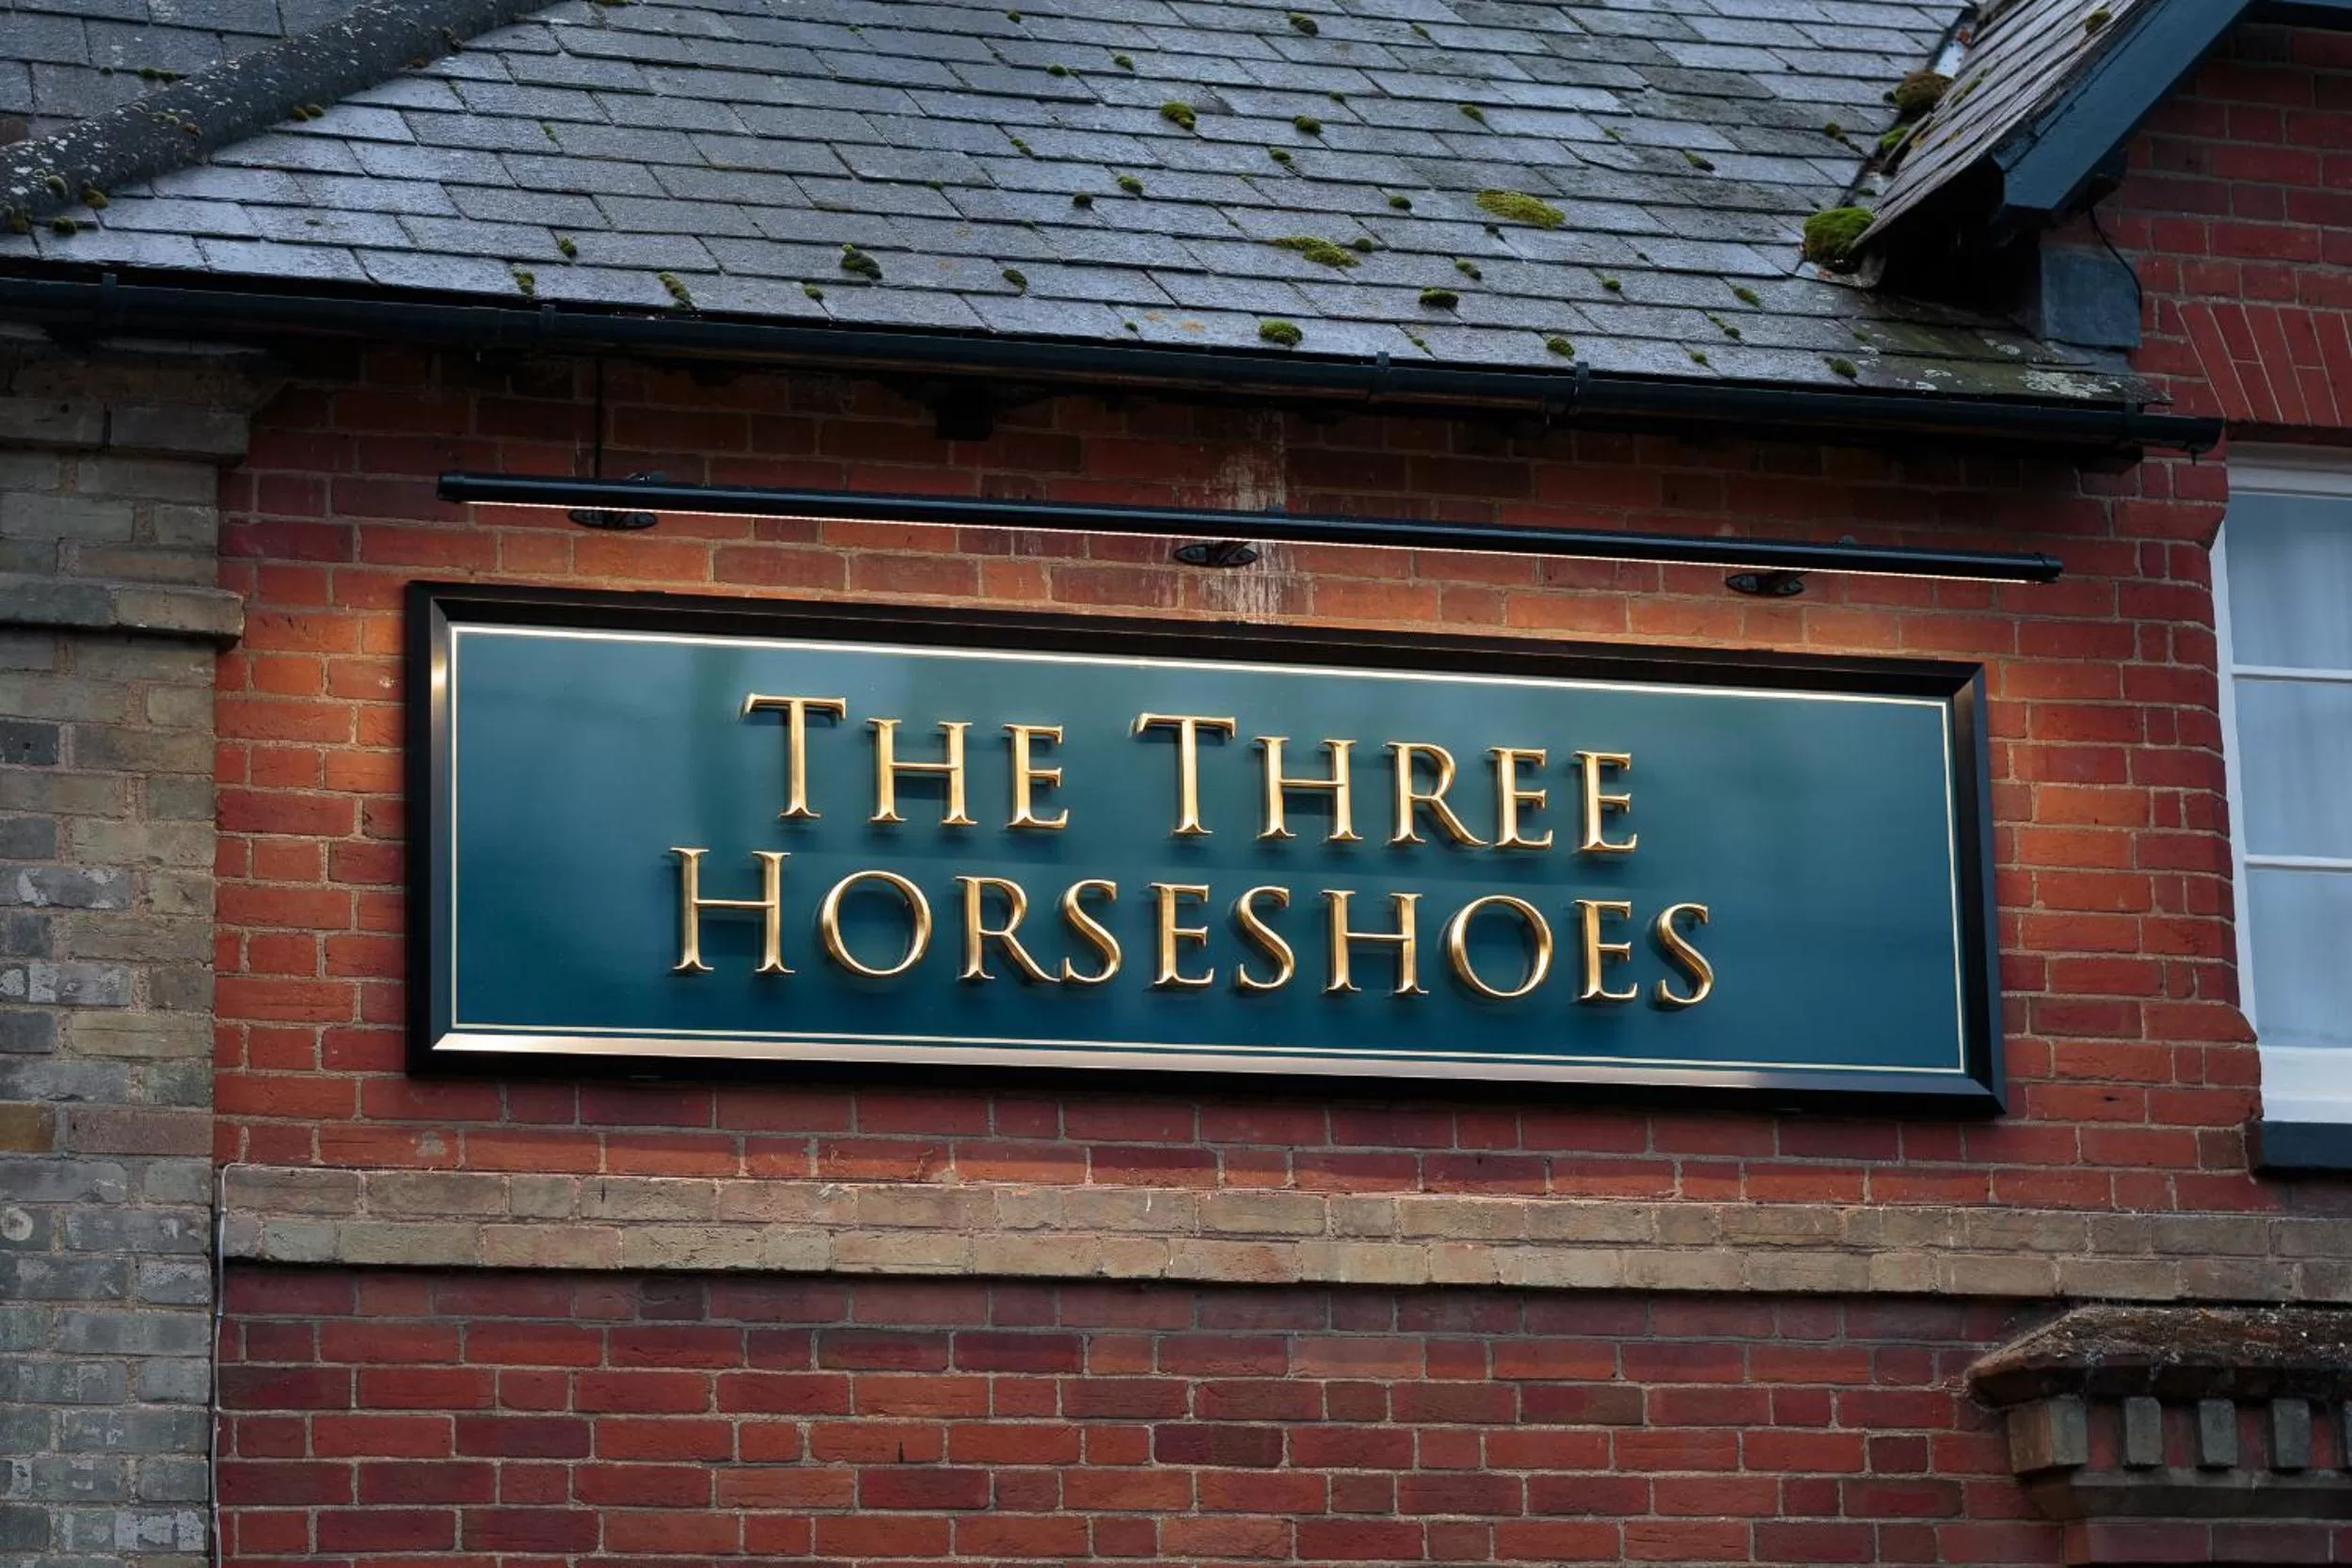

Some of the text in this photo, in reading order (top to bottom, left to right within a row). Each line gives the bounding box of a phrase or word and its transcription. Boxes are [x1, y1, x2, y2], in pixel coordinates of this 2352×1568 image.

[745, 692, 1639, 853] THE THREE
[670, 847, 1714, 1006] HORSESHOES
